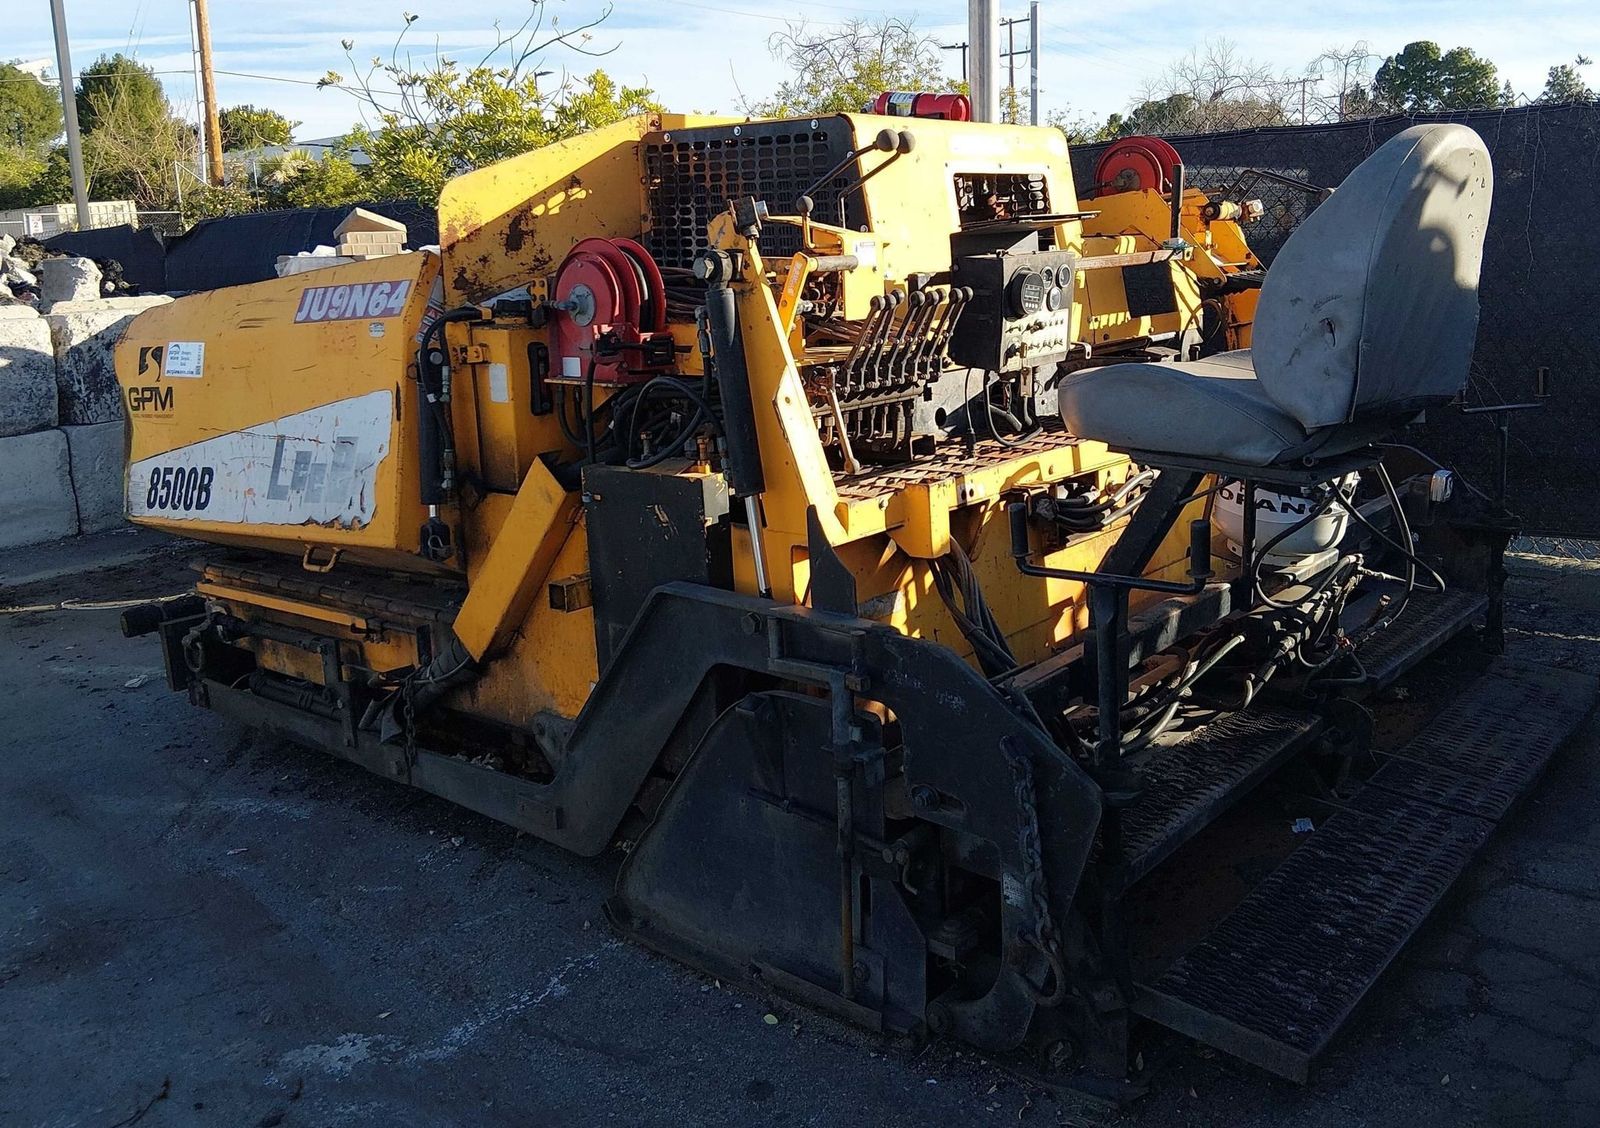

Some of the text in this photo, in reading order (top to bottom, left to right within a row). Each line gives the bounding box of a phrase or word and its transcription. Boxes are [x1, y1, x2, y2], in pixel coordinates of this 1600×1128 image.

[297, 280, 409, 321] JU9N64
[128, 386, 174, 411] GPM
[146, 466, 215, 512] 8500B
